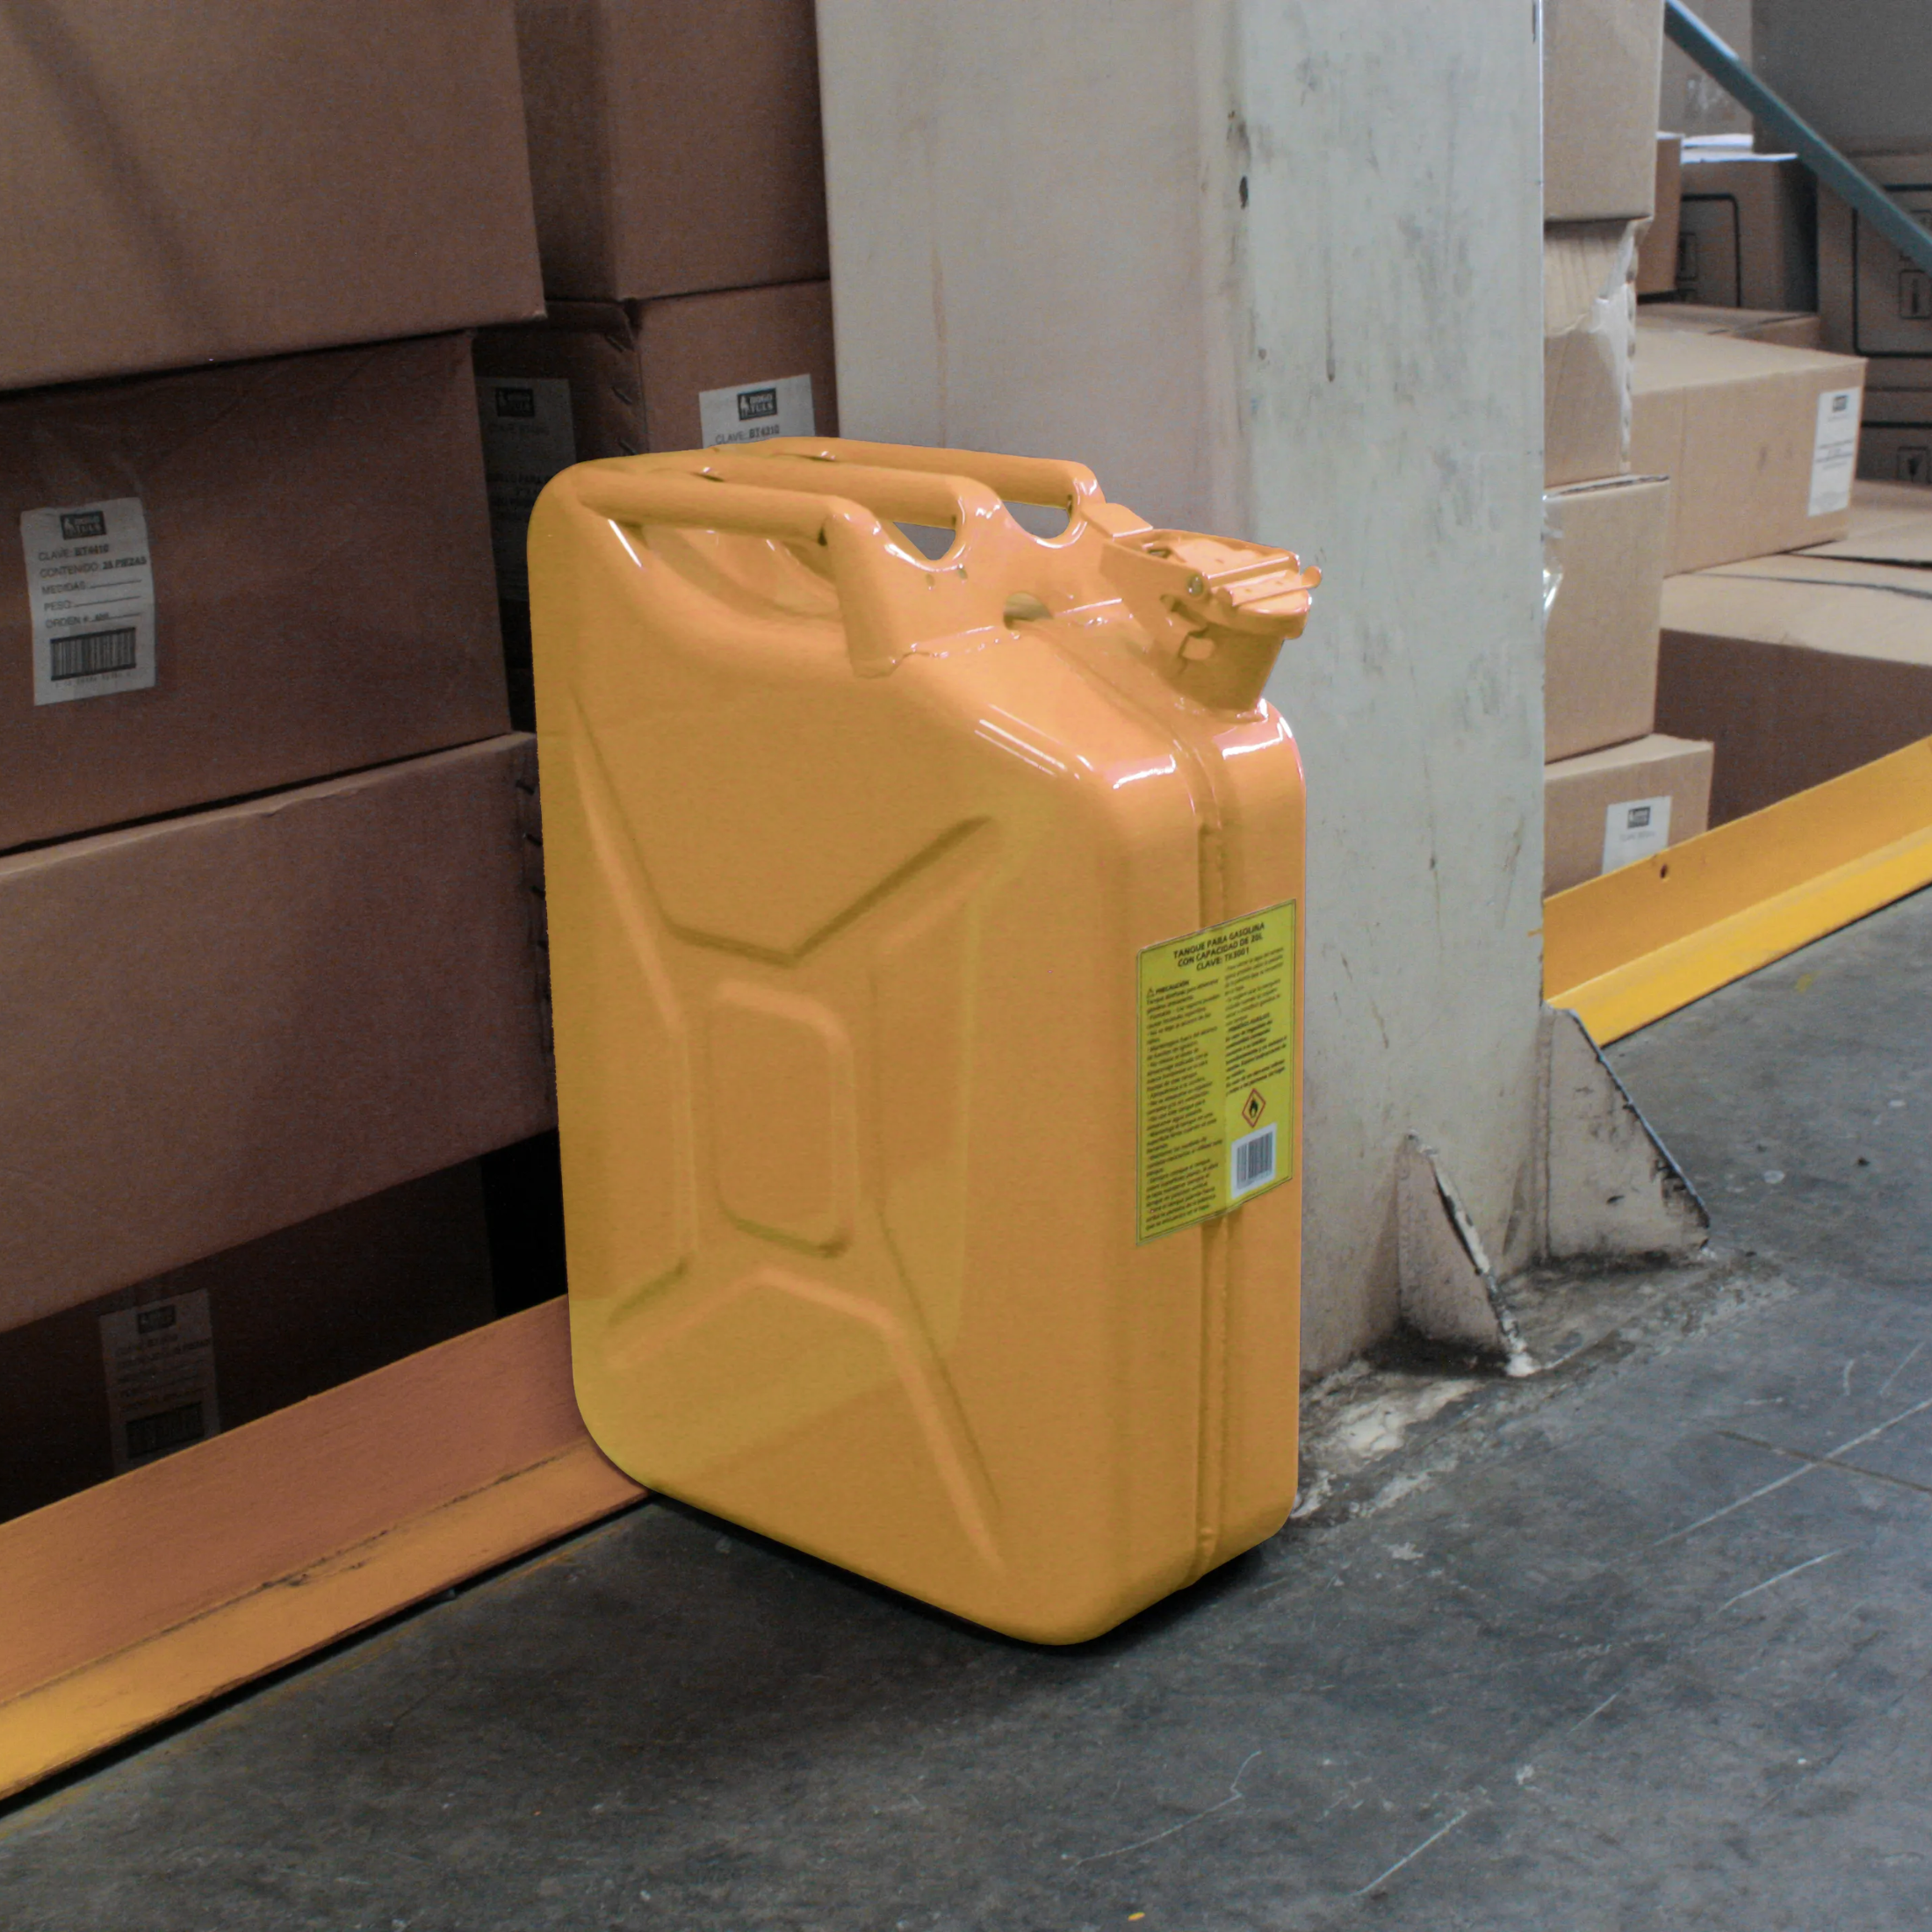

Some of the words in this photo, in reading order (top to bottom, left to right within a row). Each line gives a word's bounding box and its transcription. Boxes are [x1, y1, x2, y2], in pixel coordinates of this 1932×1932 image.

[1173, 941, 1205, 958] TANQUE
[1207, 936, 1228, 948] PARA
[1229, 922, 1265, 941] GASOLINA
[1178, 956, 1195, 968] CON
[1195, 941, 1239, 961] CAPACIDAD
[1239, 937, 1250, 947] DE
